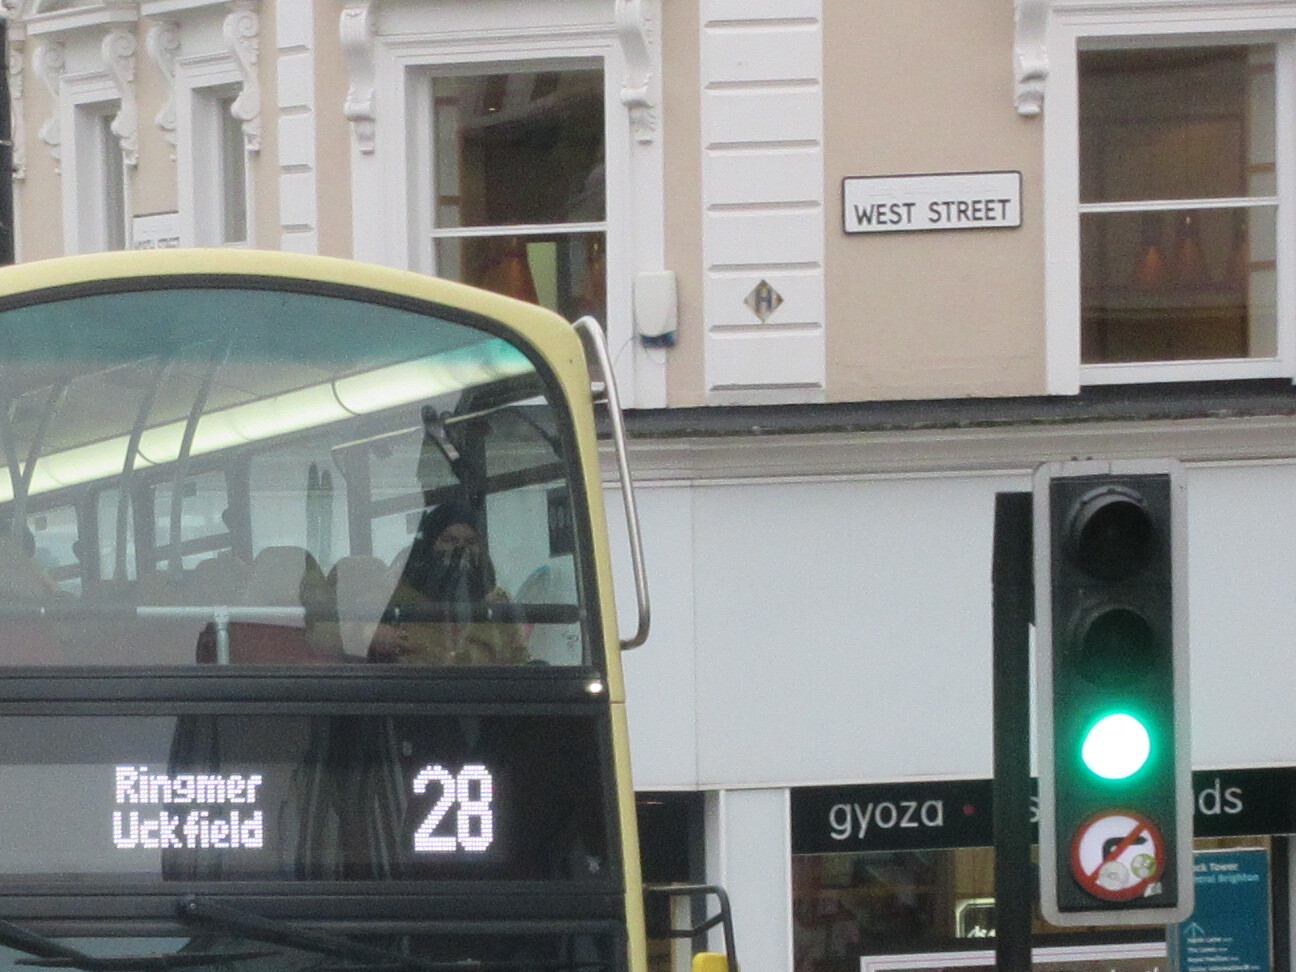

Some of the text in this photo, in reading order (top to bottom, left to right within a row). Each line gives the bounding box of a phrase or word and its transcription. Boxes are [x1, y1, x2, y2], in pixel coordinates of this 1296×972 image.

[854, 199, 1011, 226] WEST STREET
[114, 766, 263, 804] Ringmer
[412, 764, 494, 852] 28
[828, 798, 944, 840] gyoza
[112, 810, 264, 849] Uckfield
